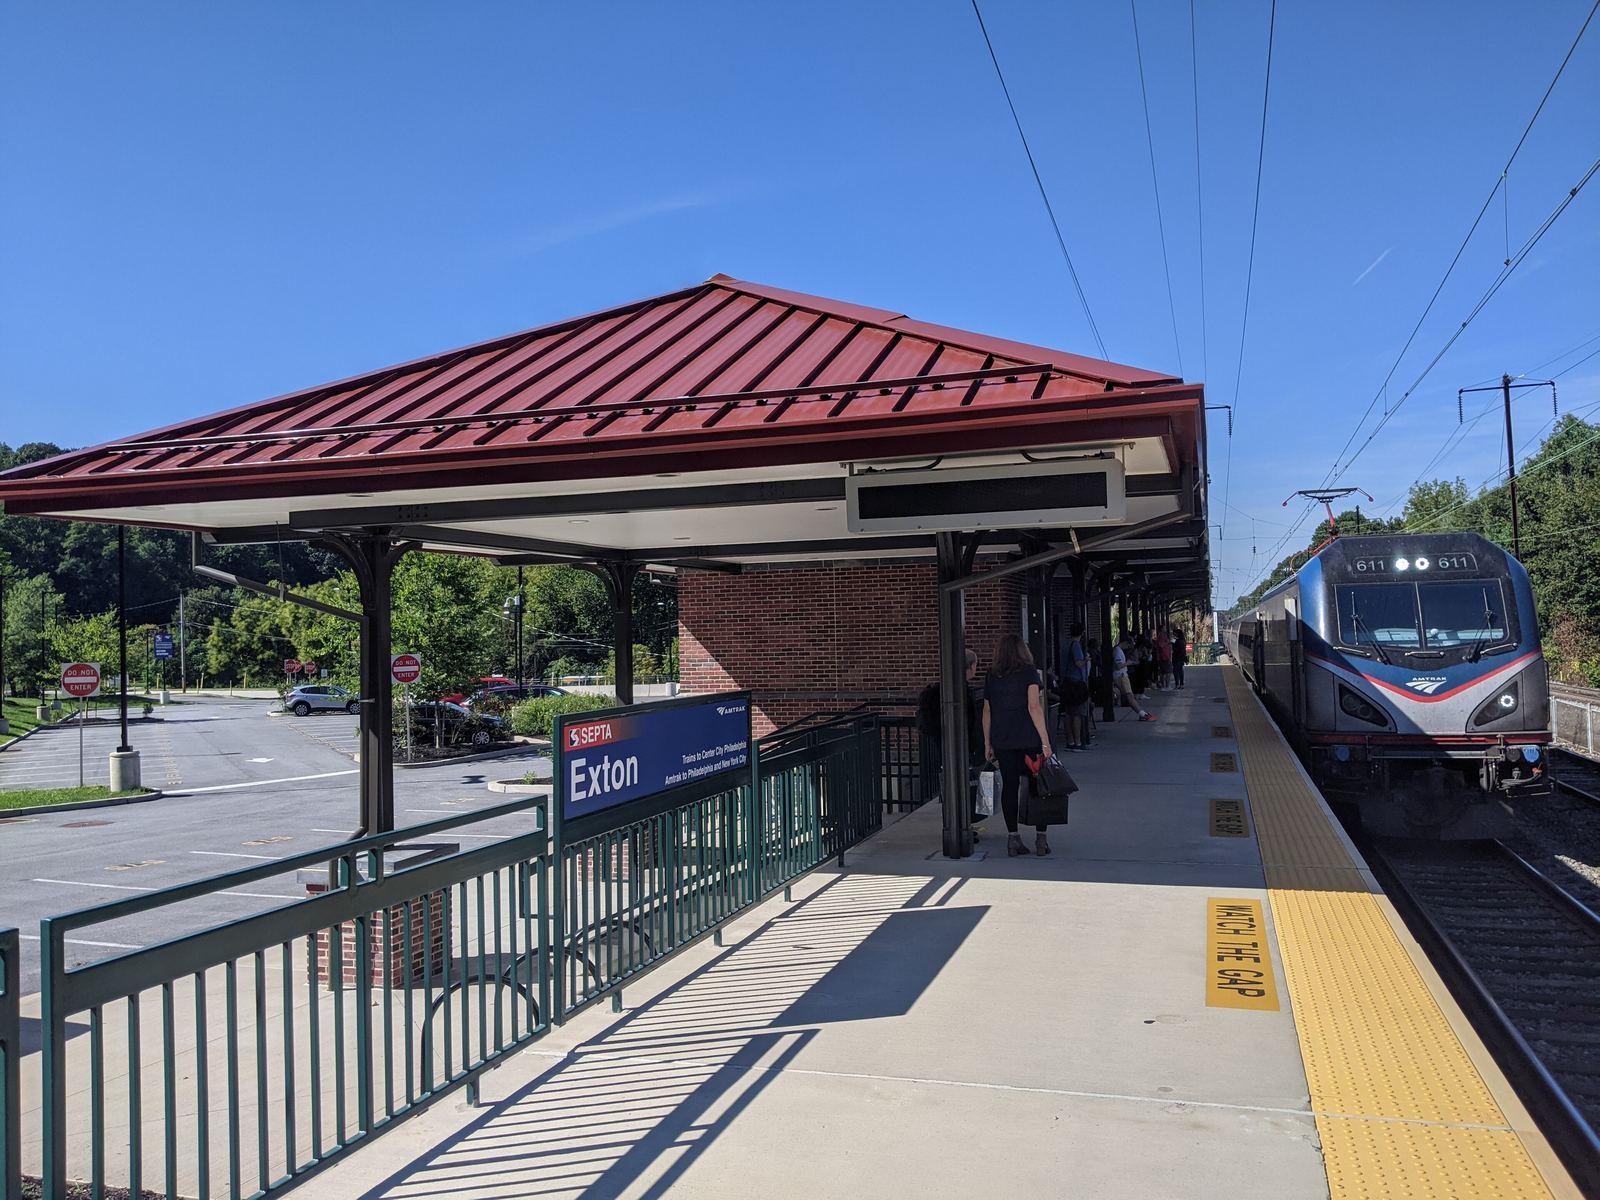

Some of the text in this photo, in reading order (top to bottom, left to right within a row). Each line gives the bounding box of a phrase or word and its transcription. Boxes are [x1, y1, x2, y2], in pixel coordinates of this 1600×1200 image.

[1356, 559, 1385, 572] 611
[1438, 556, 1467, 569] 611
[724, 705, 746, 714] AMTRAK
[581, 723, 612, 744] SEPTA
[682, 753, 697, 765] Trains
[696, 752, 702, 761] to
[702, 748, 716, 759] Center
[715, 746, 724, 757] City
[570, 754, 639, 803] Exton
[664, 772, 682, 786] Amtrak
[682, 771, 688, 780] to
[687, 763, 714, 779] Philadelphia
[713, 760, 722, 771] and
[721, 759, 731, 769] New
[738, 754, 747, 765] City
[1215, 904, 1266, 998] WATCH THE GAP
